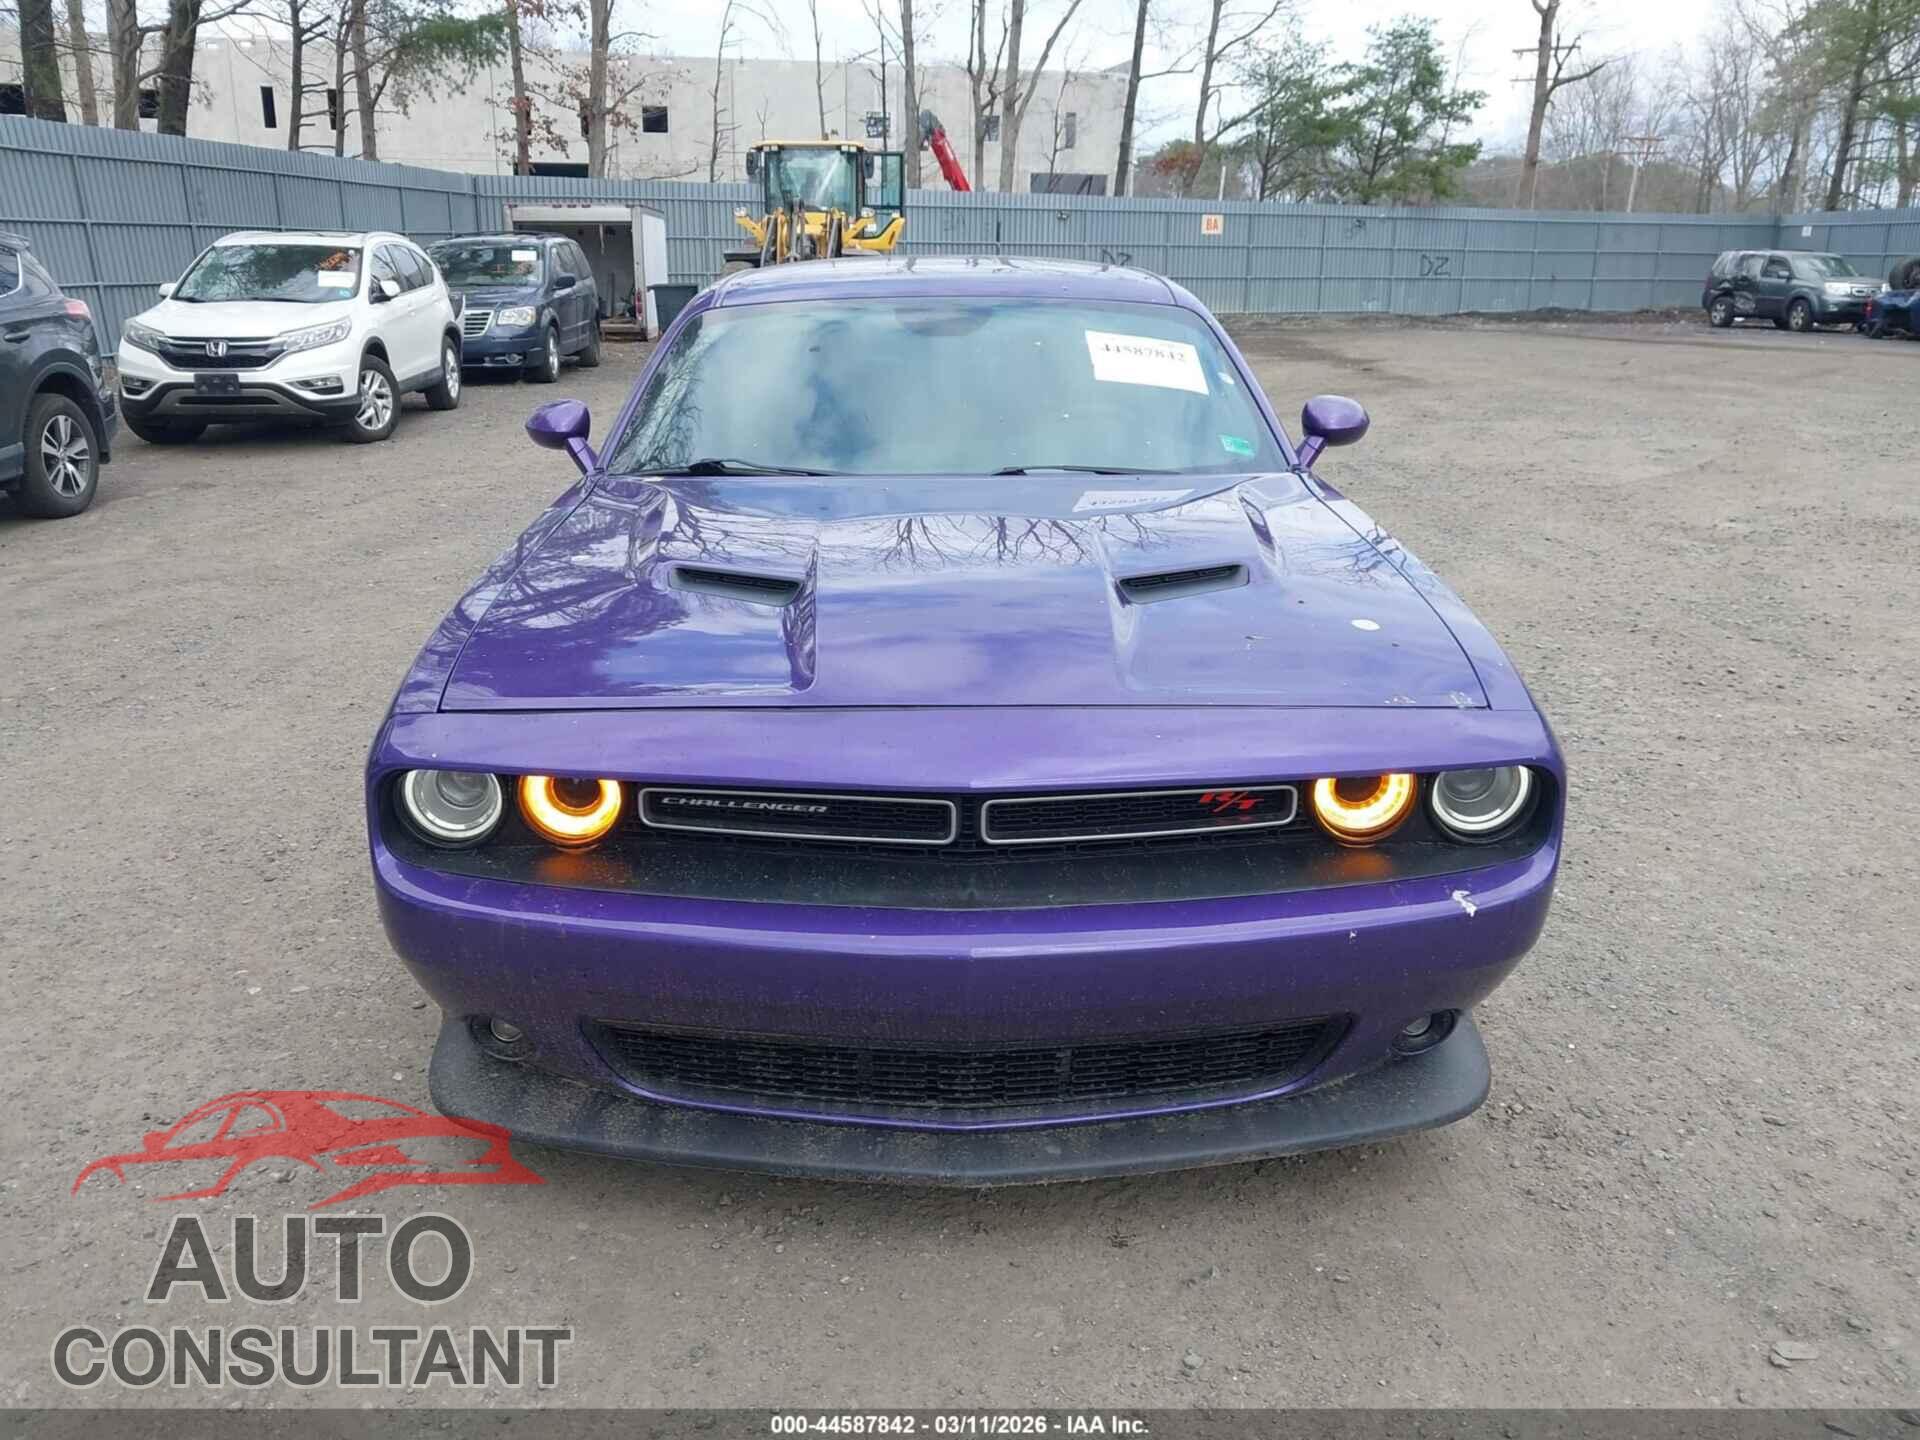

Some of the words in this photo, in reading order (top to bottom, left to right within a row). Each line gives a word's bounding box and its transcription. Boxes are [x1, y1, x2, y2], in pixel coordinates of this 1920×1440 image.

[1420, 253, 1450, 277] DZ
[661, 796, 828, 813] CHALLENGER
[1198, 788, 1264, 813] R/T
